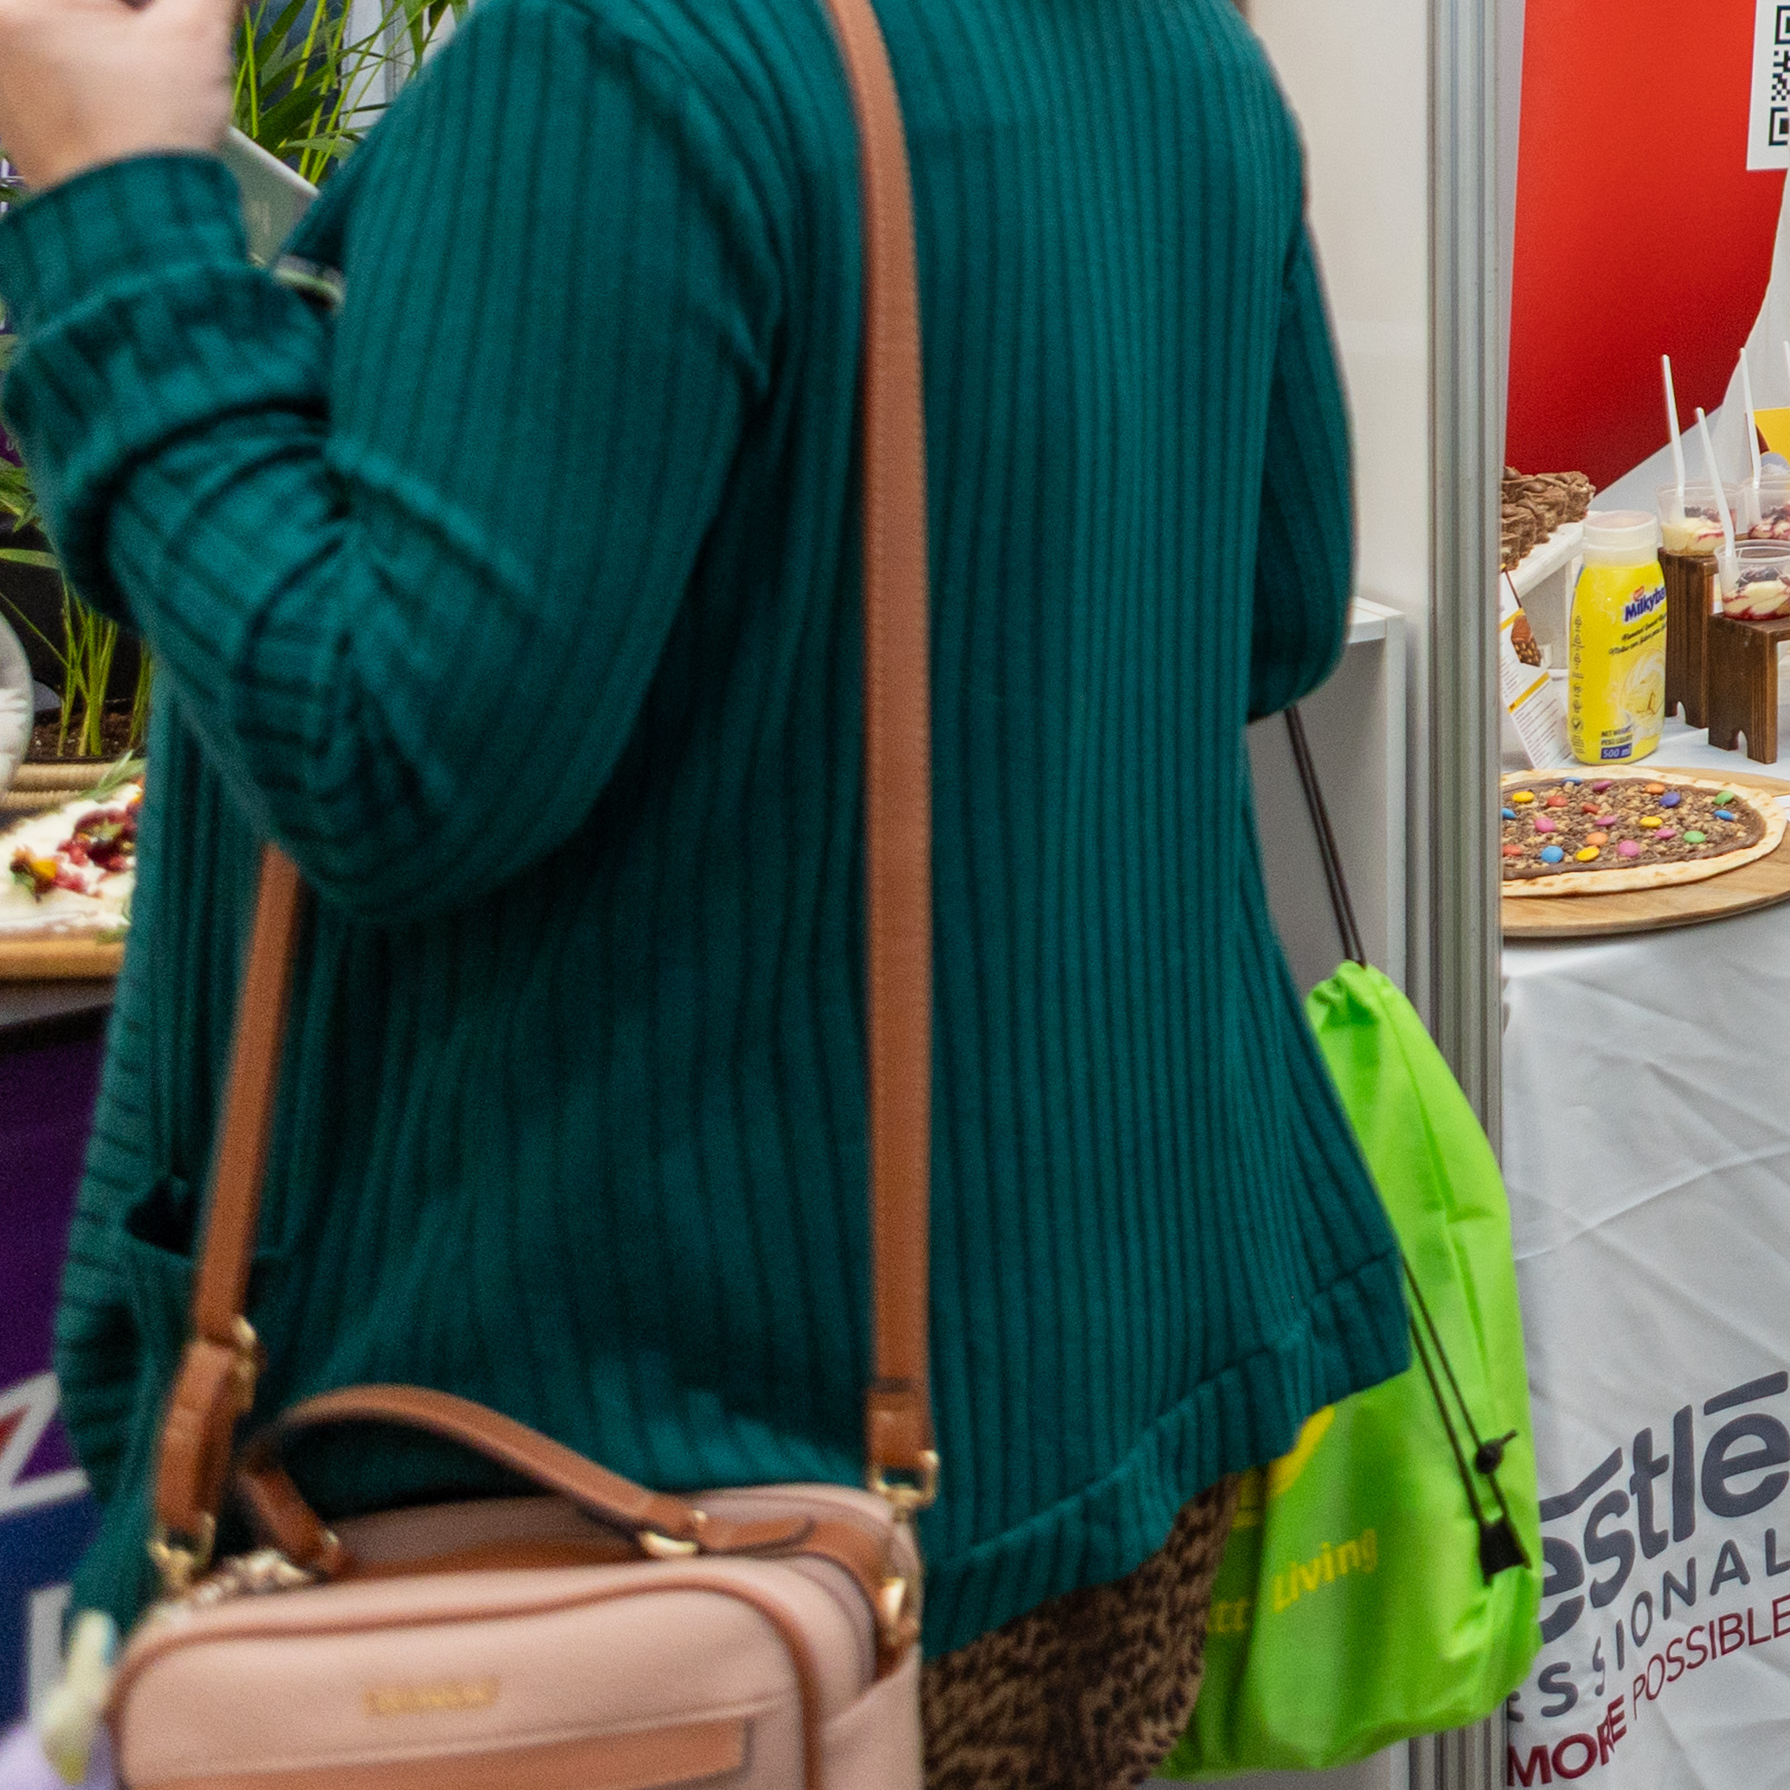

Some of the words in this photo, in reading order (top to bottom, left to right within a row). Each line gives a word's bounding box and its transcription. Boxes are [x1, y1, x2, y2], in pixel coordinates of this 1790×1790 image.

[1624, 586, 1666, 622] Milkyba
[1603, 748, 1620, 758] 500
[1507, 1695, 1627, 1787] MORE
